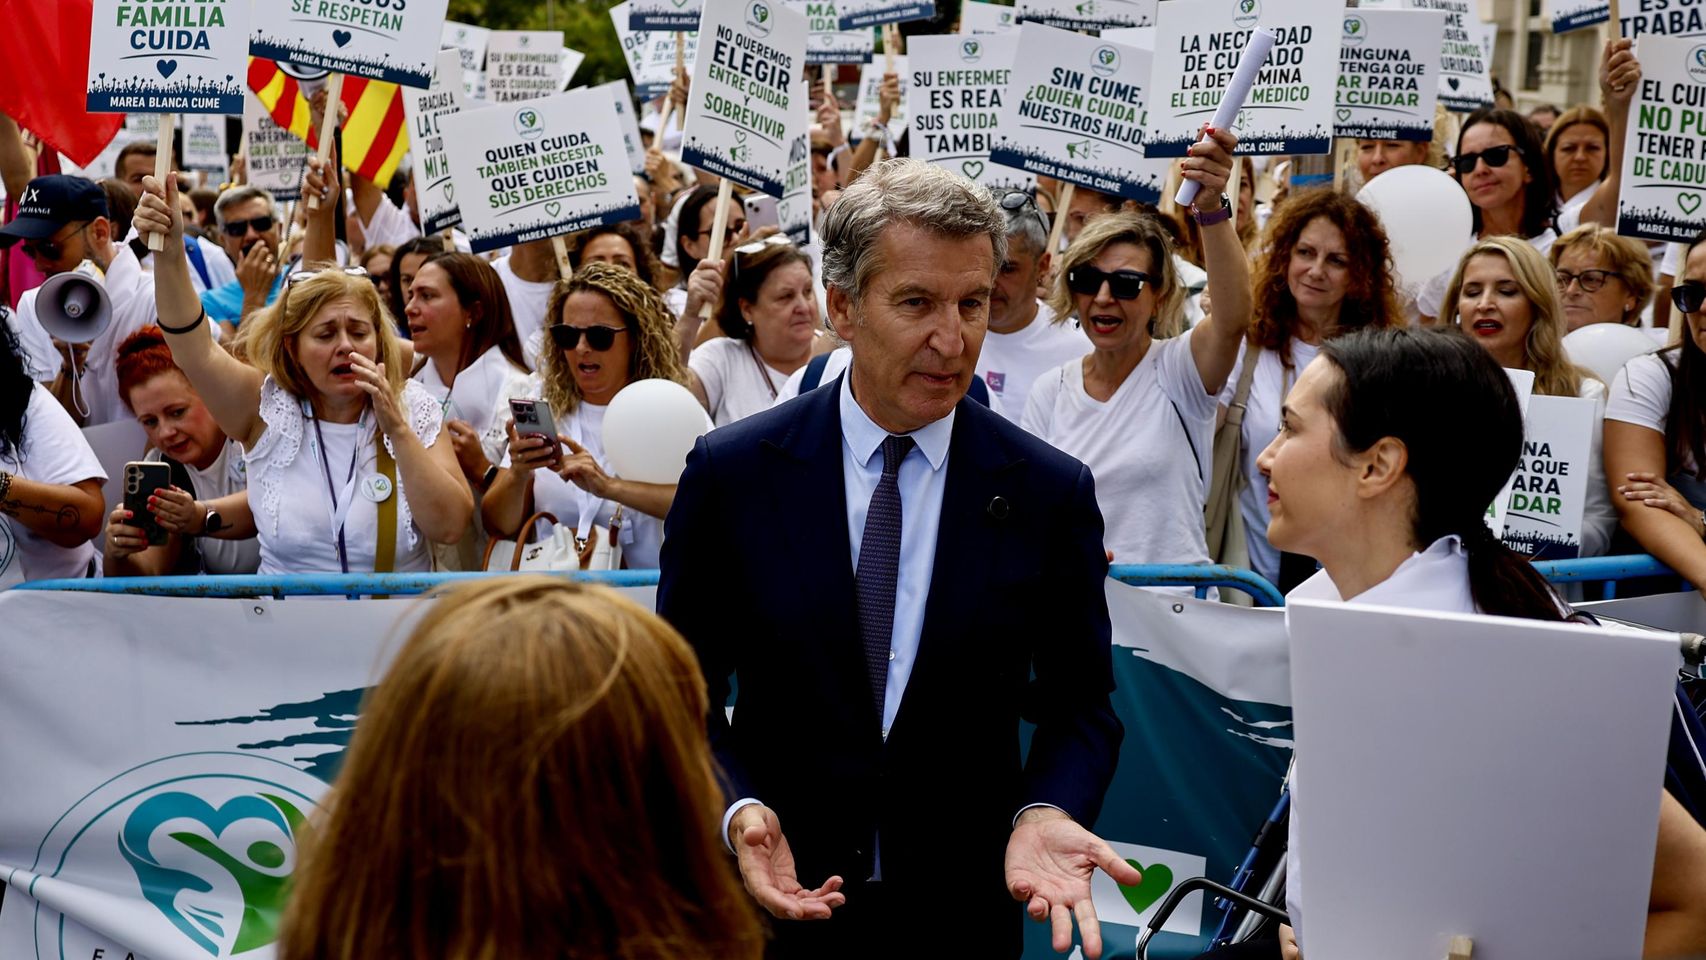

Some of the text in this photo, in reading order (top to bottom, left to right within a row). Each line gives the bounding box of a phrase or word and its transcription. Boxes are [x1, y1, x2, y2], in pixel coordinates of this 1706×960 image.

[116, 6, 225, 27] FAMILIA
[291, 0, 312, 14] SE
[317, 5, 403, 31] RESPETAN
[1444, 14, 1464, 28] ME
[1618, 8, 1703, 40] TRABA
[130, 29, 210, 50] CUIDA
[717, 24, 733, 42] NO
[735, 33, 793, 70] QUEREMOS
[1180, 34, 1201, 54] LA
[289, 52, 384, 78] MAREA BLANCA CUME
[713, 39, 791, 93] ELEGIR
[1184, 46, 1304, 72] DE CUADO
[1340, 62, 1426, 76] TENGA QUE
[1440, 57, 1484, 75] URIDAD
[498, 65, 512, 77] ES
[914, 72, 932, 87] SU
[1181, 67, 1302, 90] LA DETMINA
[708, 64, 790, 111] ENTRE CUIDAR
[1051, 67, 1143, 109] SIN CUME,
[1337, 75, 1419, 91] AR PARA
[1641, 79, 1706, 108] EL CUI
[110, 96, 220, 109] MAREA BLANCA CUME
[743, 95, 751, 106] Y
[930, 89, 1004, 109] ES REA
[1171, 93, 1187, 108] EL
[1252, 85, 1310, 104] MÉDICO
[1346, 91, 1419, 107] CUIDAR
[704, 92, 785, 140] SOBREVIVIR
[916, 113, 998, 130] SUS CUIDA
[1018, 100, 1102, 135] NUESTROS
[1087, 97, 1136, 124] CUIDA
[1638, 104, 1672, 131] NO
[416, 114, 433, 138] LA
[1335, 128, 1398, 139] LANCA CUME
[485, 141, 537, 163] QUIEN
[540, 132, 591, 151] CUIDA
[924, 133, 991, 153] TAMBI
[1258, 141, 1286, 152] CUME
[1637, 132, 1695, 160] TENER
[541, 144, 604, 166] NECESITA
[424, 156, 438, 180] MI
[491, 159, 600, 192] QUE CUIDEN
[1023, 160, 1122, 193] MAREA BLANCA CUME
[1634, 156, 1706, 184] DE CADU
[488, 172, 608, 209] SUS DERECHOS
[517, 217, 603, 243] MAREA BLANCA CUME
[1637, 222, 1671, 236] MAREA
[1523, 441, 1552, 458] NA
[1531, 459, 1570, 476] QUE
[1511, 474, 1561, 495] ARA
